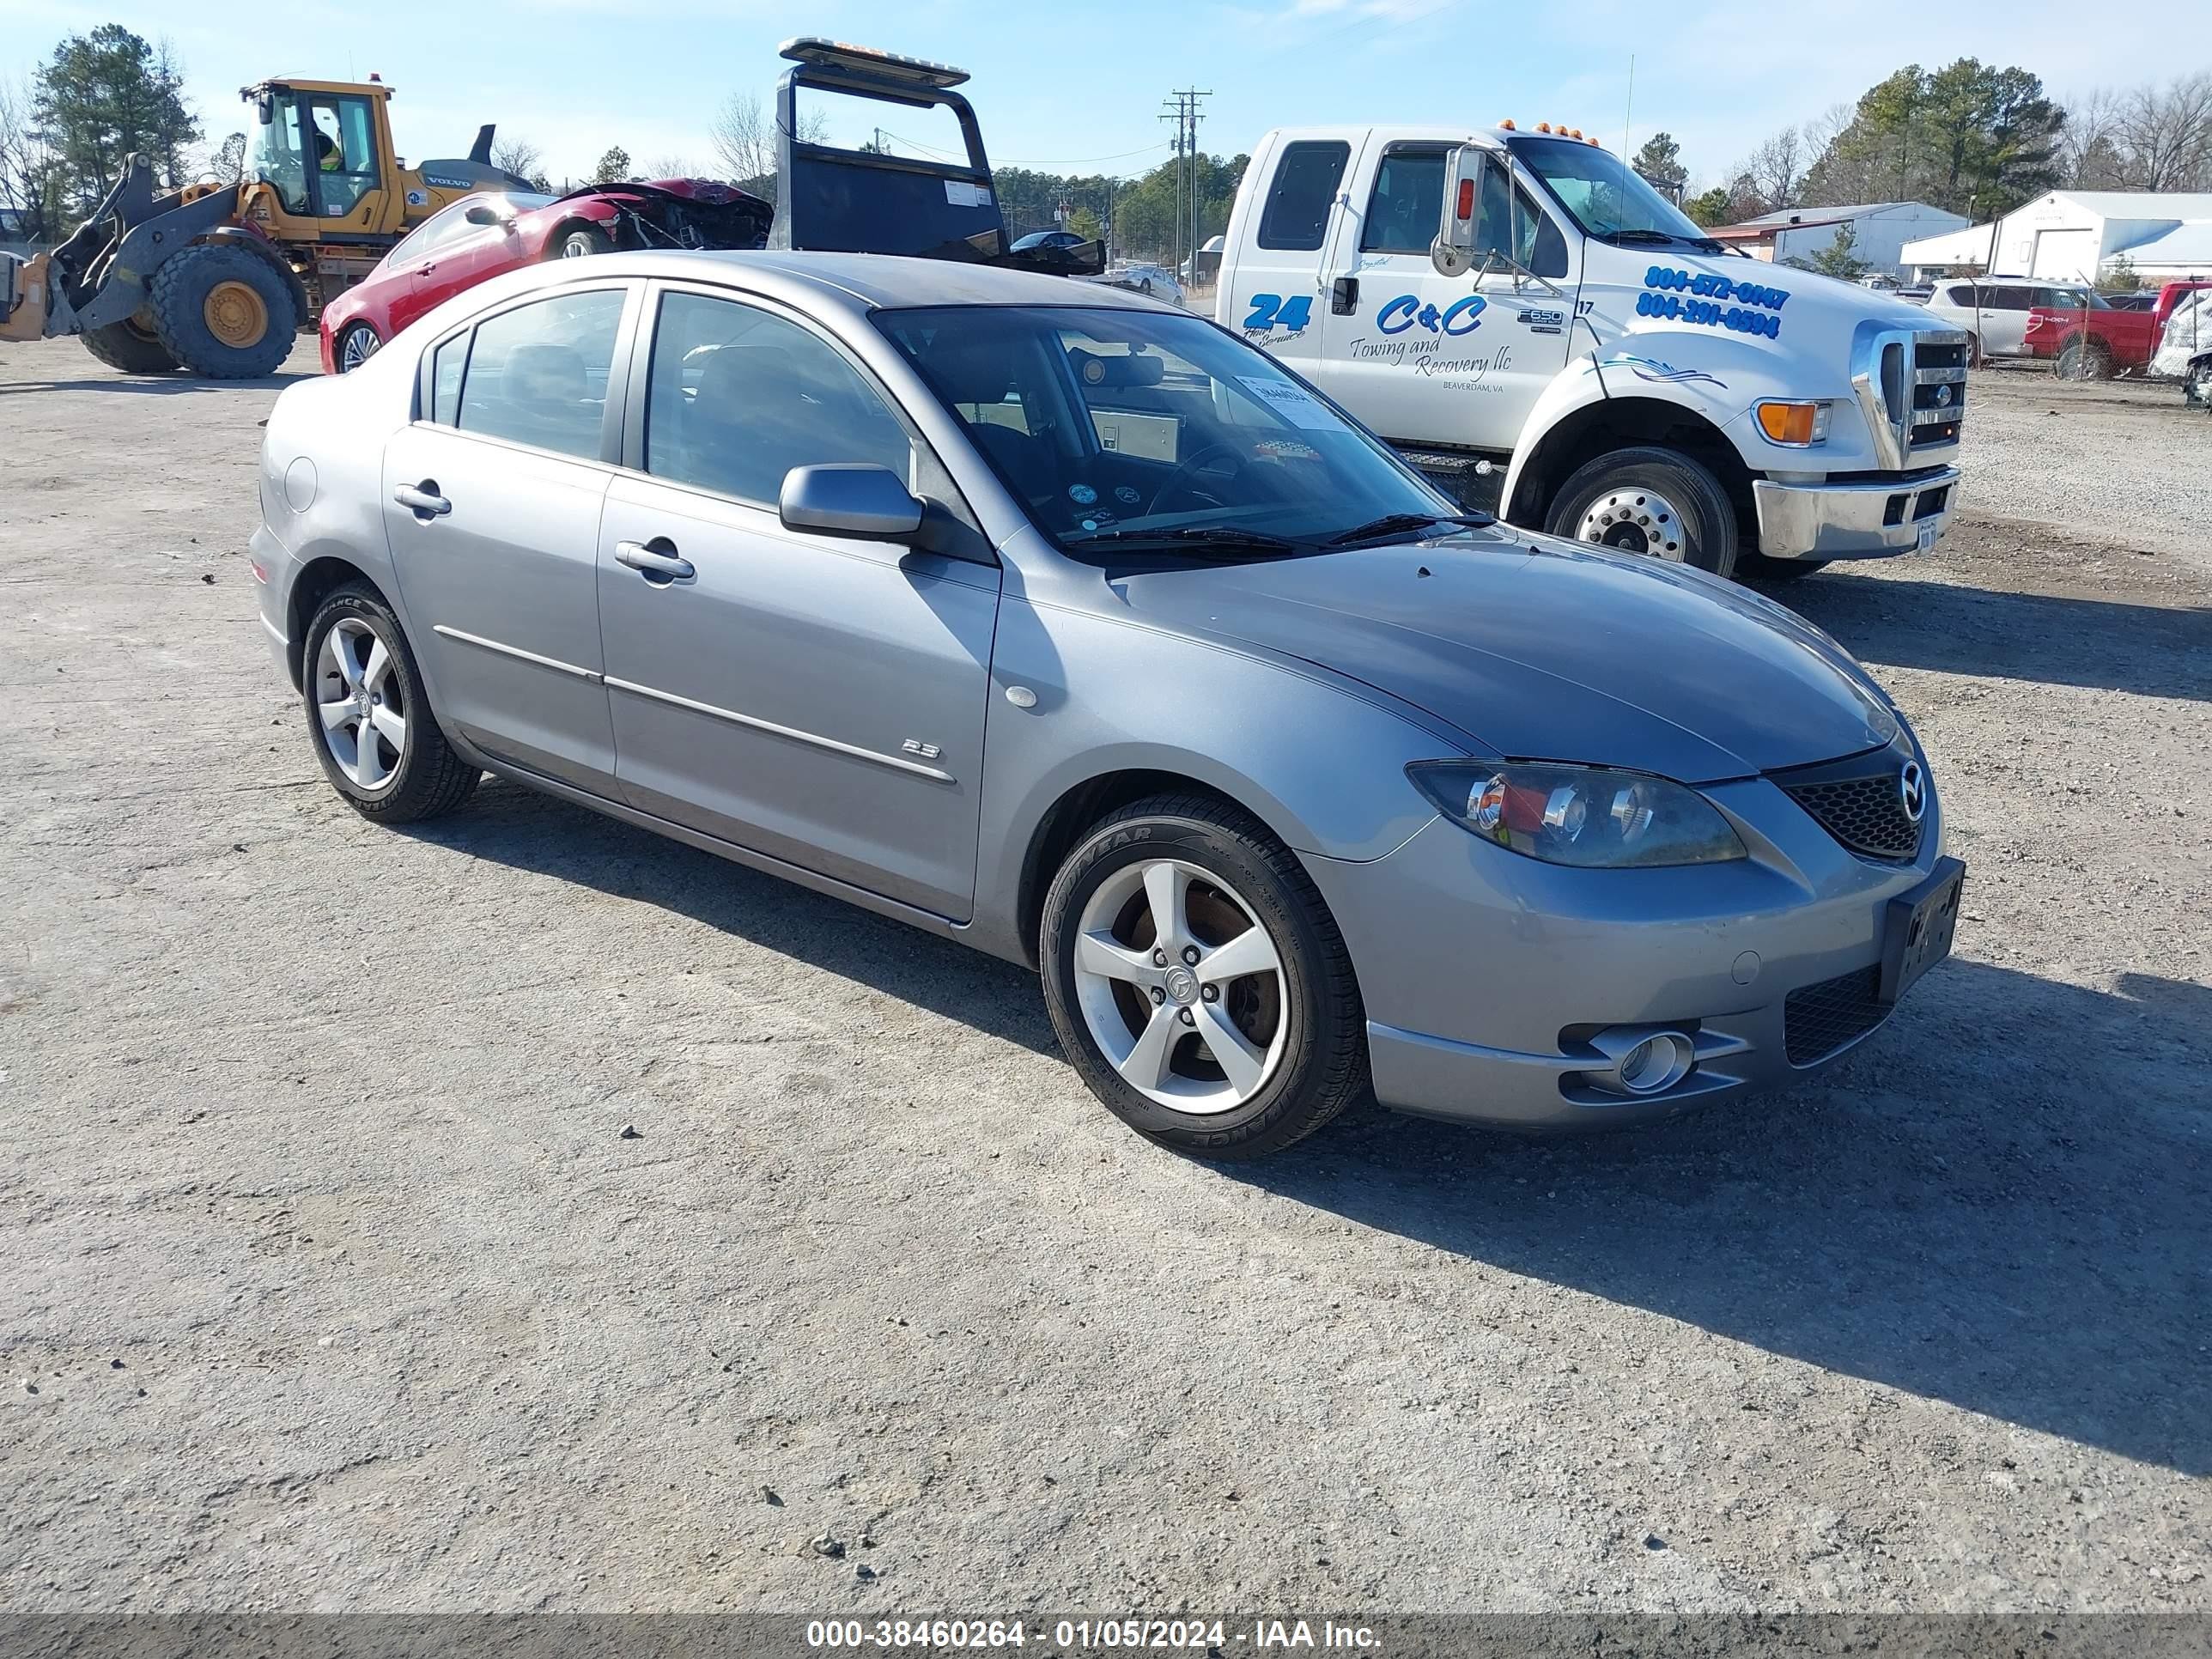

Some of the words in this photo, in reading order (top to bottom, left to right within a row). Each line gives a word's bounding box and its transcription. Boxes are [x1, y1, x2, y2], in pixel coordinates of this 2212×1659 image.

[428, 177, 471, 187] VOLVO
[1644, 265, 1791, 311] 804-572-0147
[1243, 293, 1314, 331] 24
[1376, 295, 1488, 337] C&C
[1518, 309, 1563, 321] F650
[1579, 301, 1595, 314] 17
[1636, 292, 1781, 340] 804-291-8594
[1258, 331, 1306, 347] Service
[1351, 338, 1406, 367] Towing
[1409, 329, 1446, 353] and
[1415, 355, 1489, 383] Recovery
[1493, 345, 1512, 371] llc
[1443, 381, 1492, 393] BEAVERDAM,
[1492, 385, 1504, 393] VA
[1048, 827, 1152, 955] GOODYEAR
